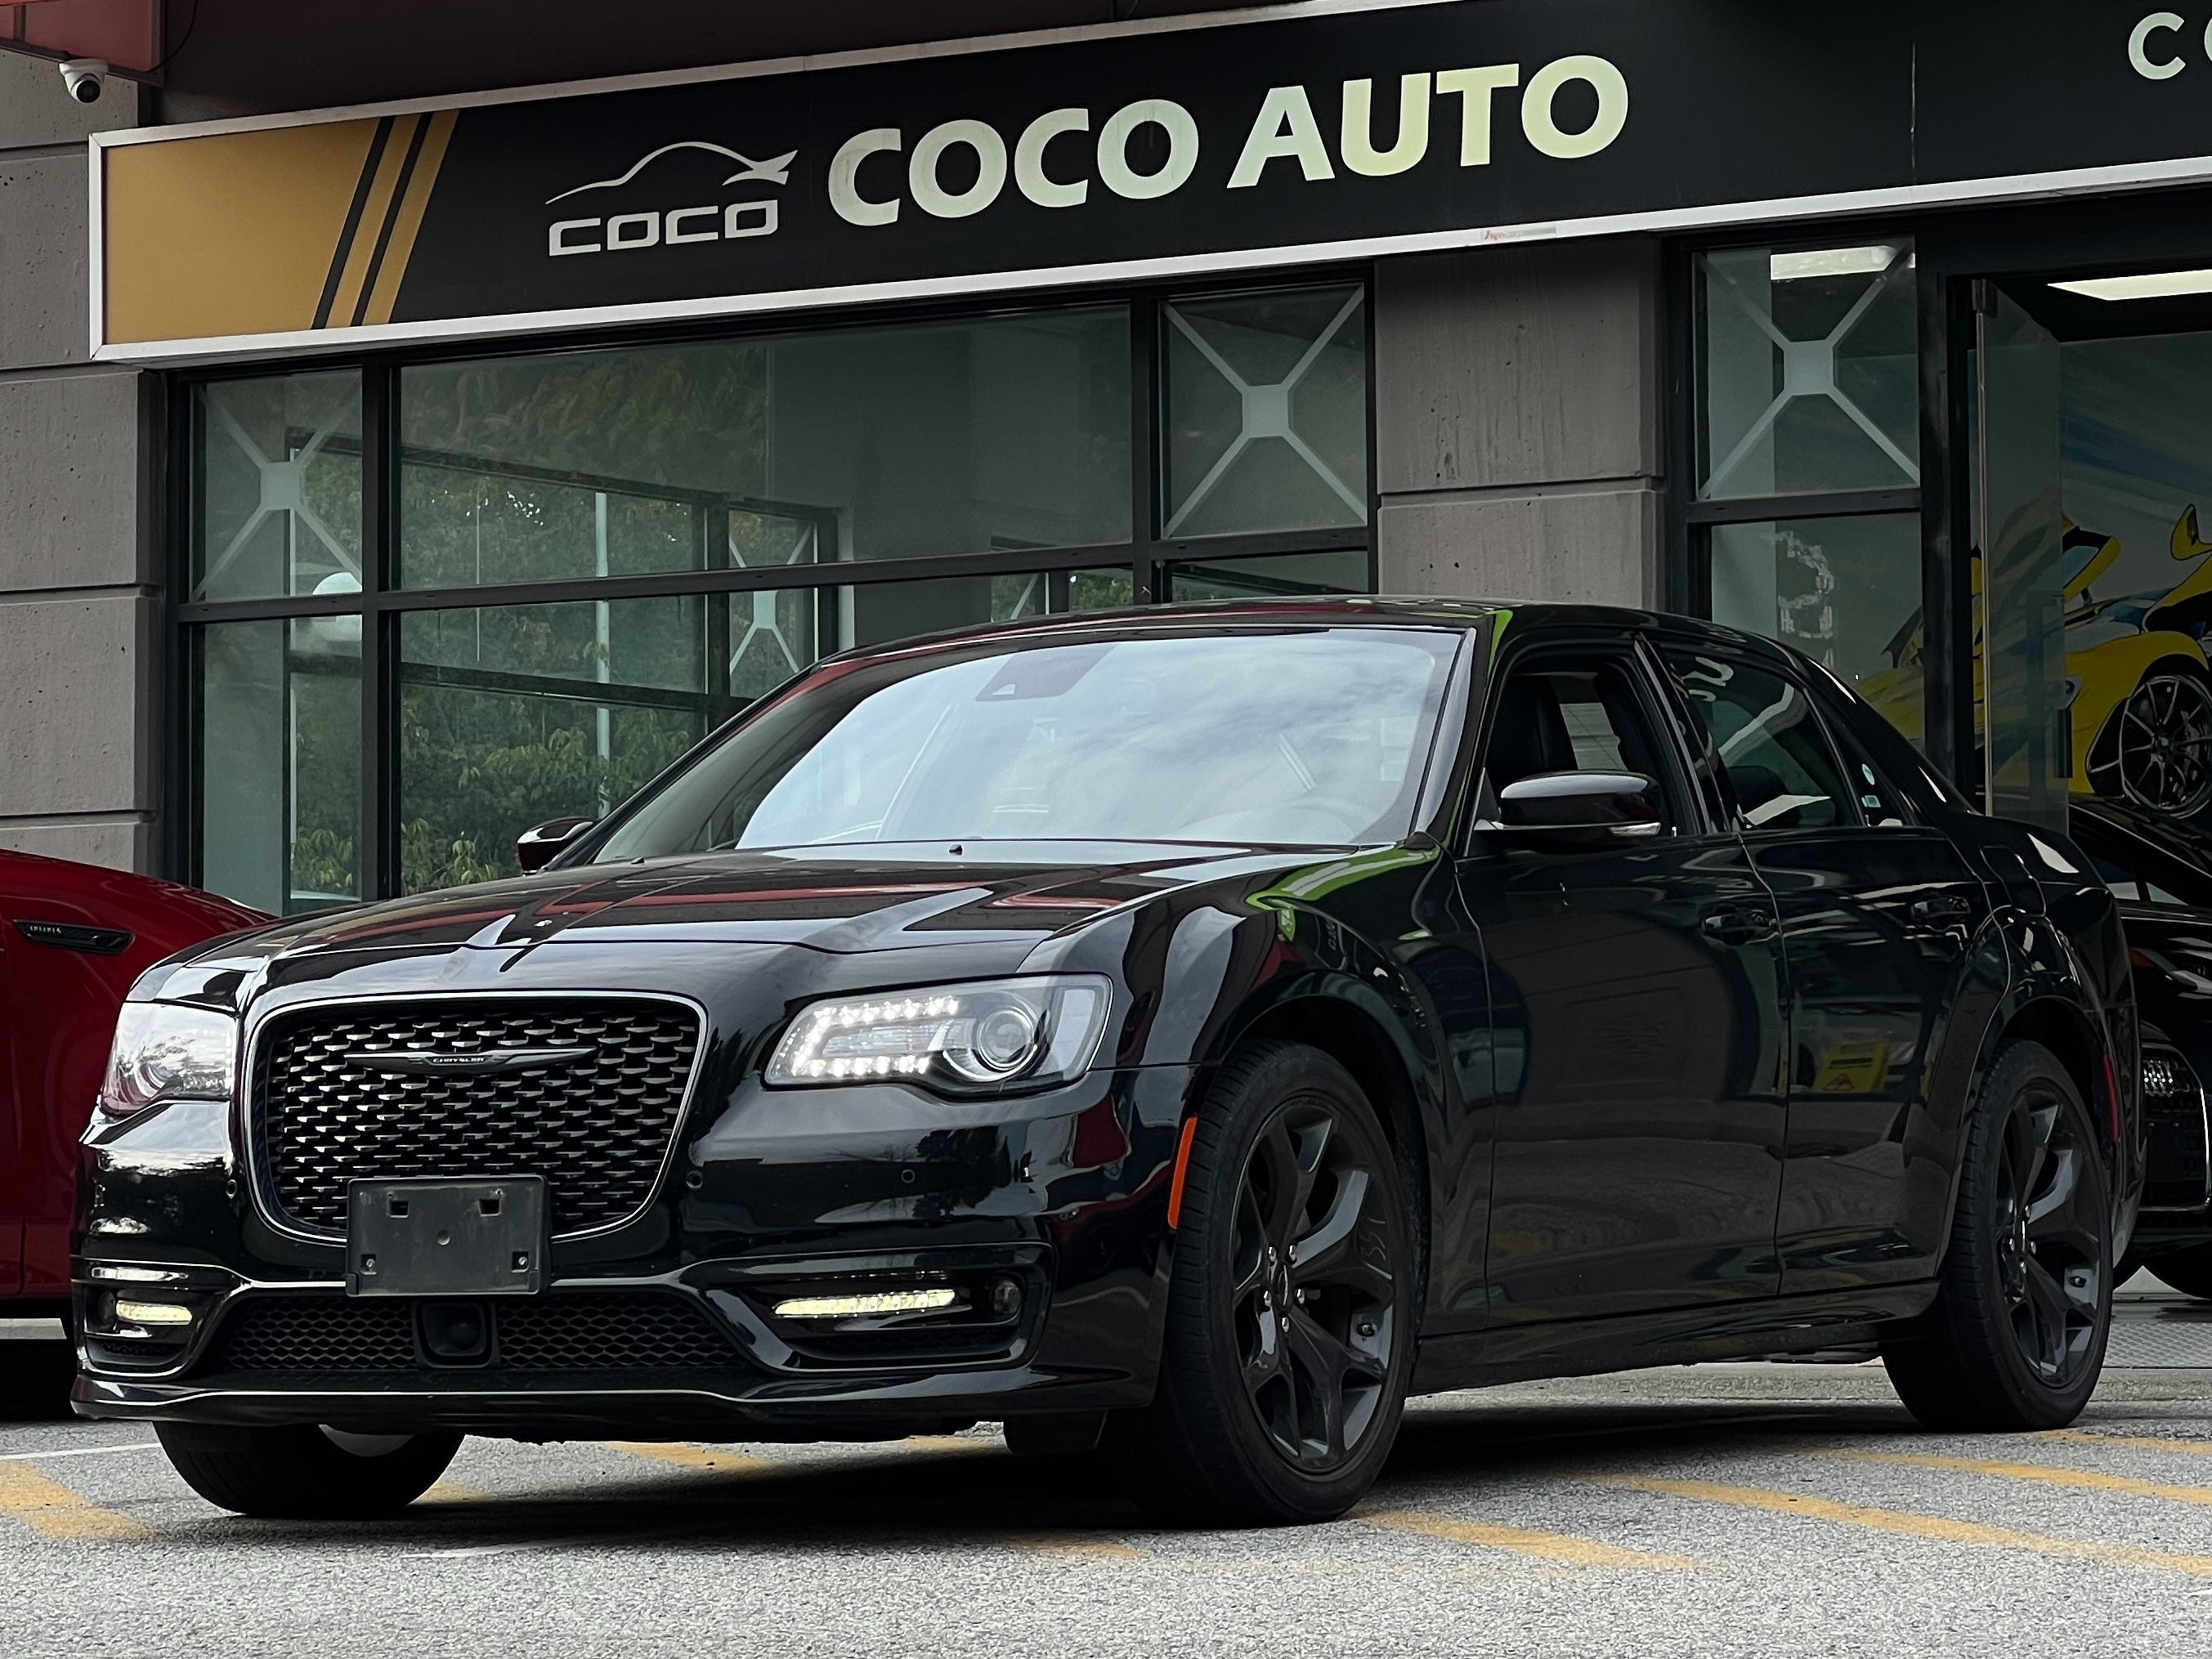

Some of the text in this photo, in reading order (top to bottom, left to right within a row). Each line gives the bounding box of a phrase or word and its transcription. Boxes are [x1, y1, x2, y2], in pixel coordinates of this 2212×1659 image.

[2128, 11, 2212, 80] C
[828, 55, 1628, 226] COCO AUTO
[549, 199, 778, 256] COCO
